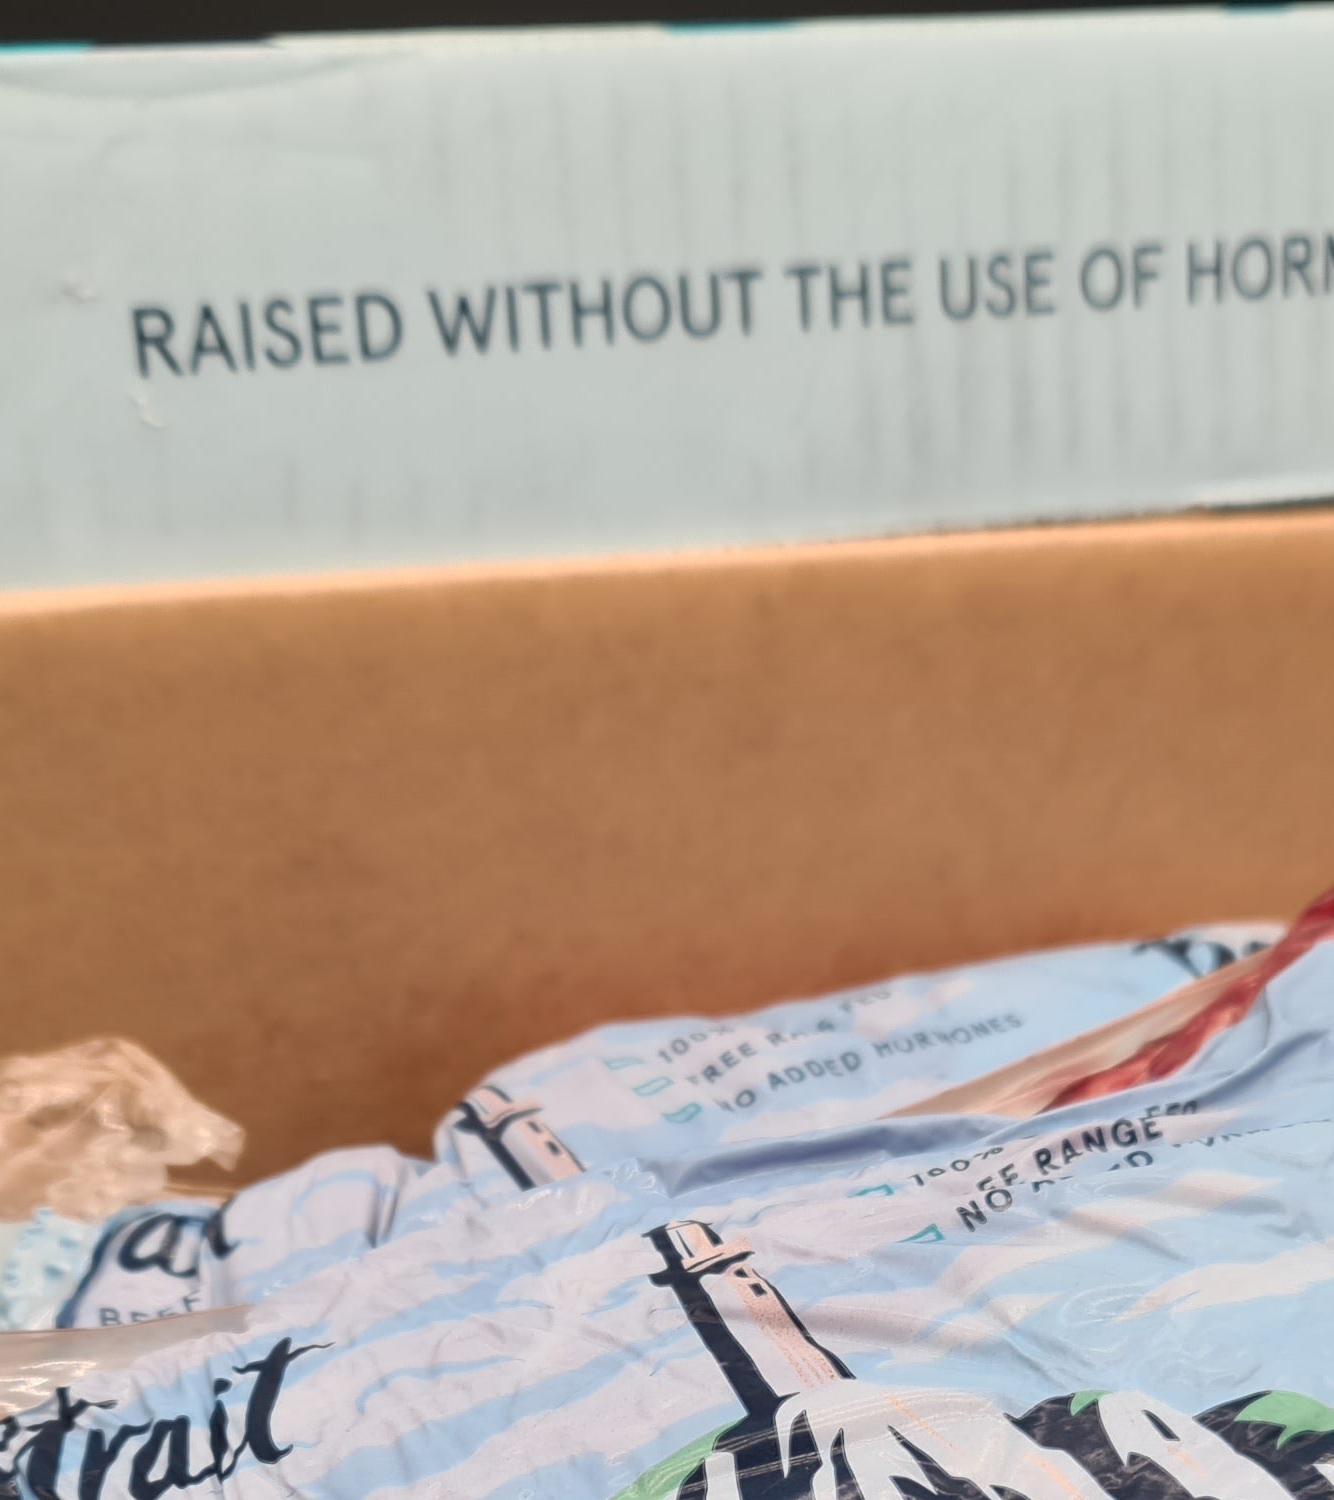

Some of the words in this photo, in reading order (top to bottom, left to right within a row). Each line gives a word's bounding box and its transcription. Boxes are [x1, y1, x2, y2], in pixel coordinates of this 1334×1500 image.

[131, 291, 402, 379] RAISED
[426, 267, 765, 358] WITHOUT
[784, 257, 913, 334] THE
[938, 247, 1057, 322] USE
[1079, 242, 1160, 313] OF
[768, 1051, 861, 1090] ADDED
[1033, 1117, 1163, 1175] RANGE
[956, 1189, 1012, 1232] NO
